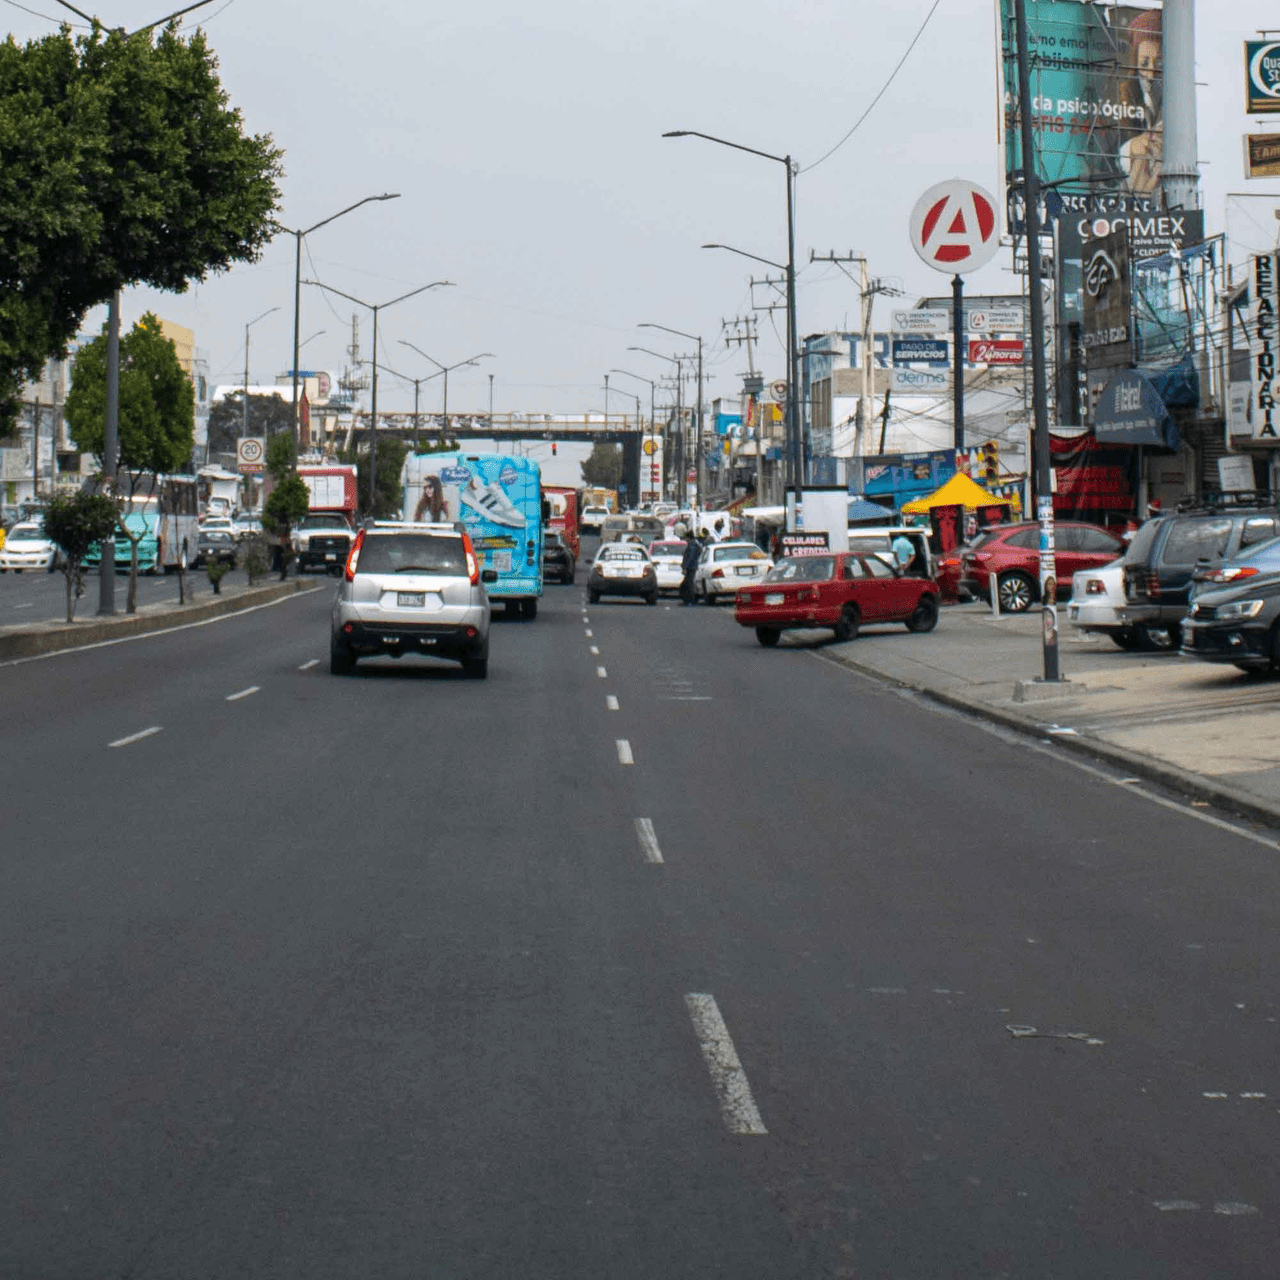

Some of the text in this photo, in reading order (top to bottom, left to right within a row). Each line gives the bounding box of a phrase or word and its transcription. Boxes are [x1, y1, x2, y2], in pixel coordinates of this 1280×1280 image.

[926, 343, 937, 351] DE
[1255, 255, 1278, 438] REFACCIONARIA
[895, 351, 946, 359] SERVICIOS
[244, 443, 258, 455] 20
